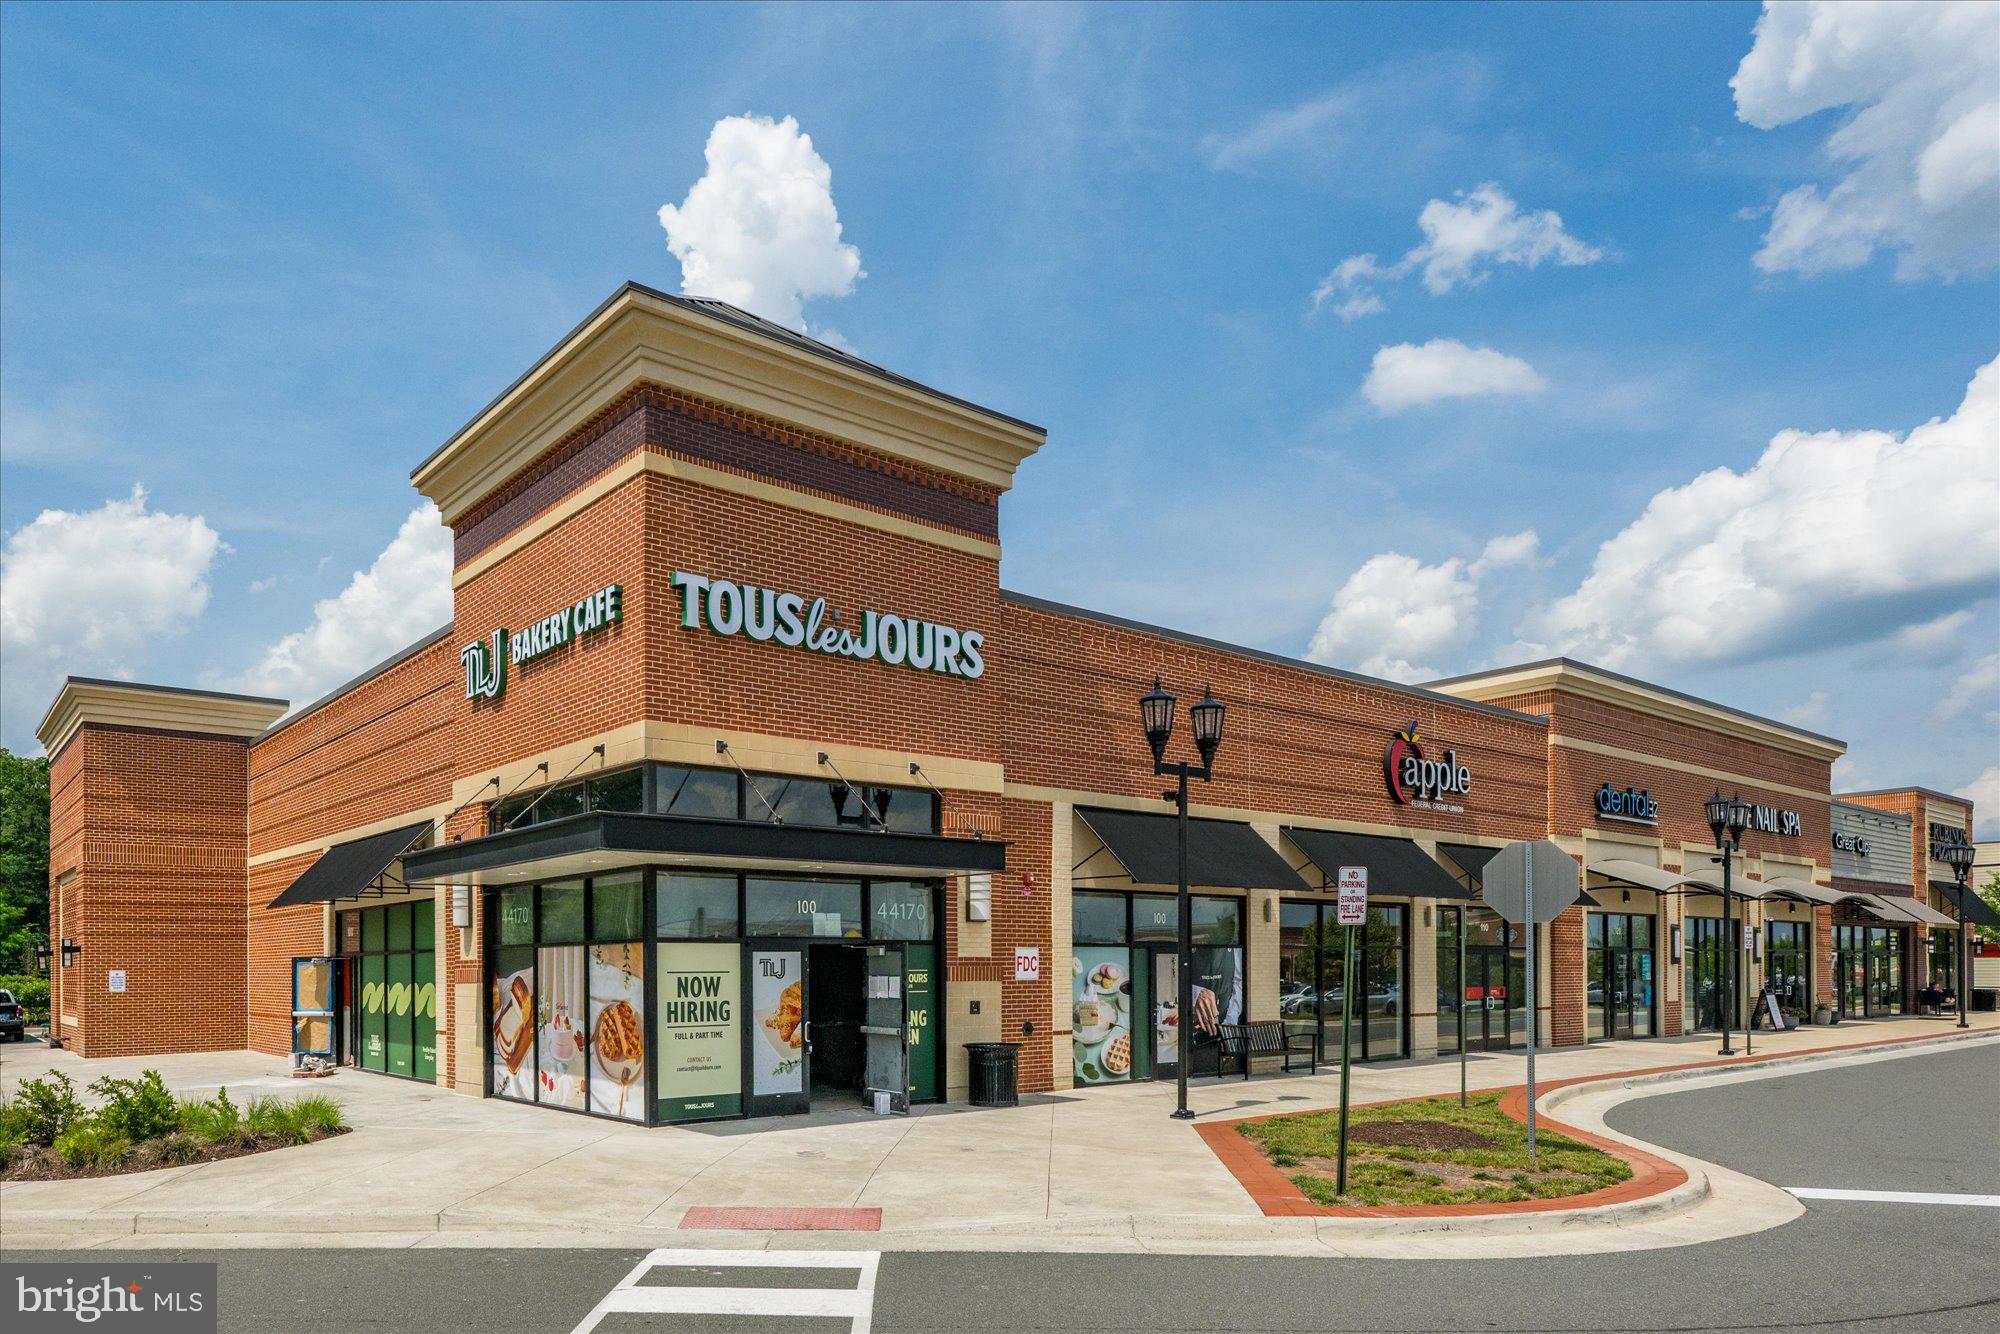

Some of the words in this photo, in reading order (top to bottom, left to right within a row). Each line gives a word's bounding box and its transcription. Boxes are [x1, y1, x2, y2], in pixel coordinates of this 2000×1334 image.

[512, 607, 572, 664] BAKERY
[574, 585, 619, 634] CAFE
[674, 571, 805, 646] TOUS
[855, 610, 985, 678] JOURS
[1405, 750, 1470, 800] apple
[1411, 800, 1431, 809] FEDERAL
[1433, 803, 1448, 811] CREDIT
[1449, 805, 1464, 813] UNION
[1756, 805, 1779, 833] NAIL
[1783, 810, 1801, 836] SPA
[1836, 833, 1856, 852] Great
[1858, 837, 1872, 856] Clips
[1348, 871, 1358, 879] NO
[797, 900, 817, 914] 100
[877, 903, 926, 919] 44170
[1341, 905, 1350, 913] FIRE
[1352, 905, 1364, 913] LANE
[1154, 912, 1166, 924] 100
[1480, 923, 1489, 931] 110
[759, 959, 786, 979] TLJ
[1017, 956, 1037, 971] FDC
[908, 973, 928, 983] OURS
[677, 976, 721, 998] NOW
[667, 1000, 730, 1023] HIRING
